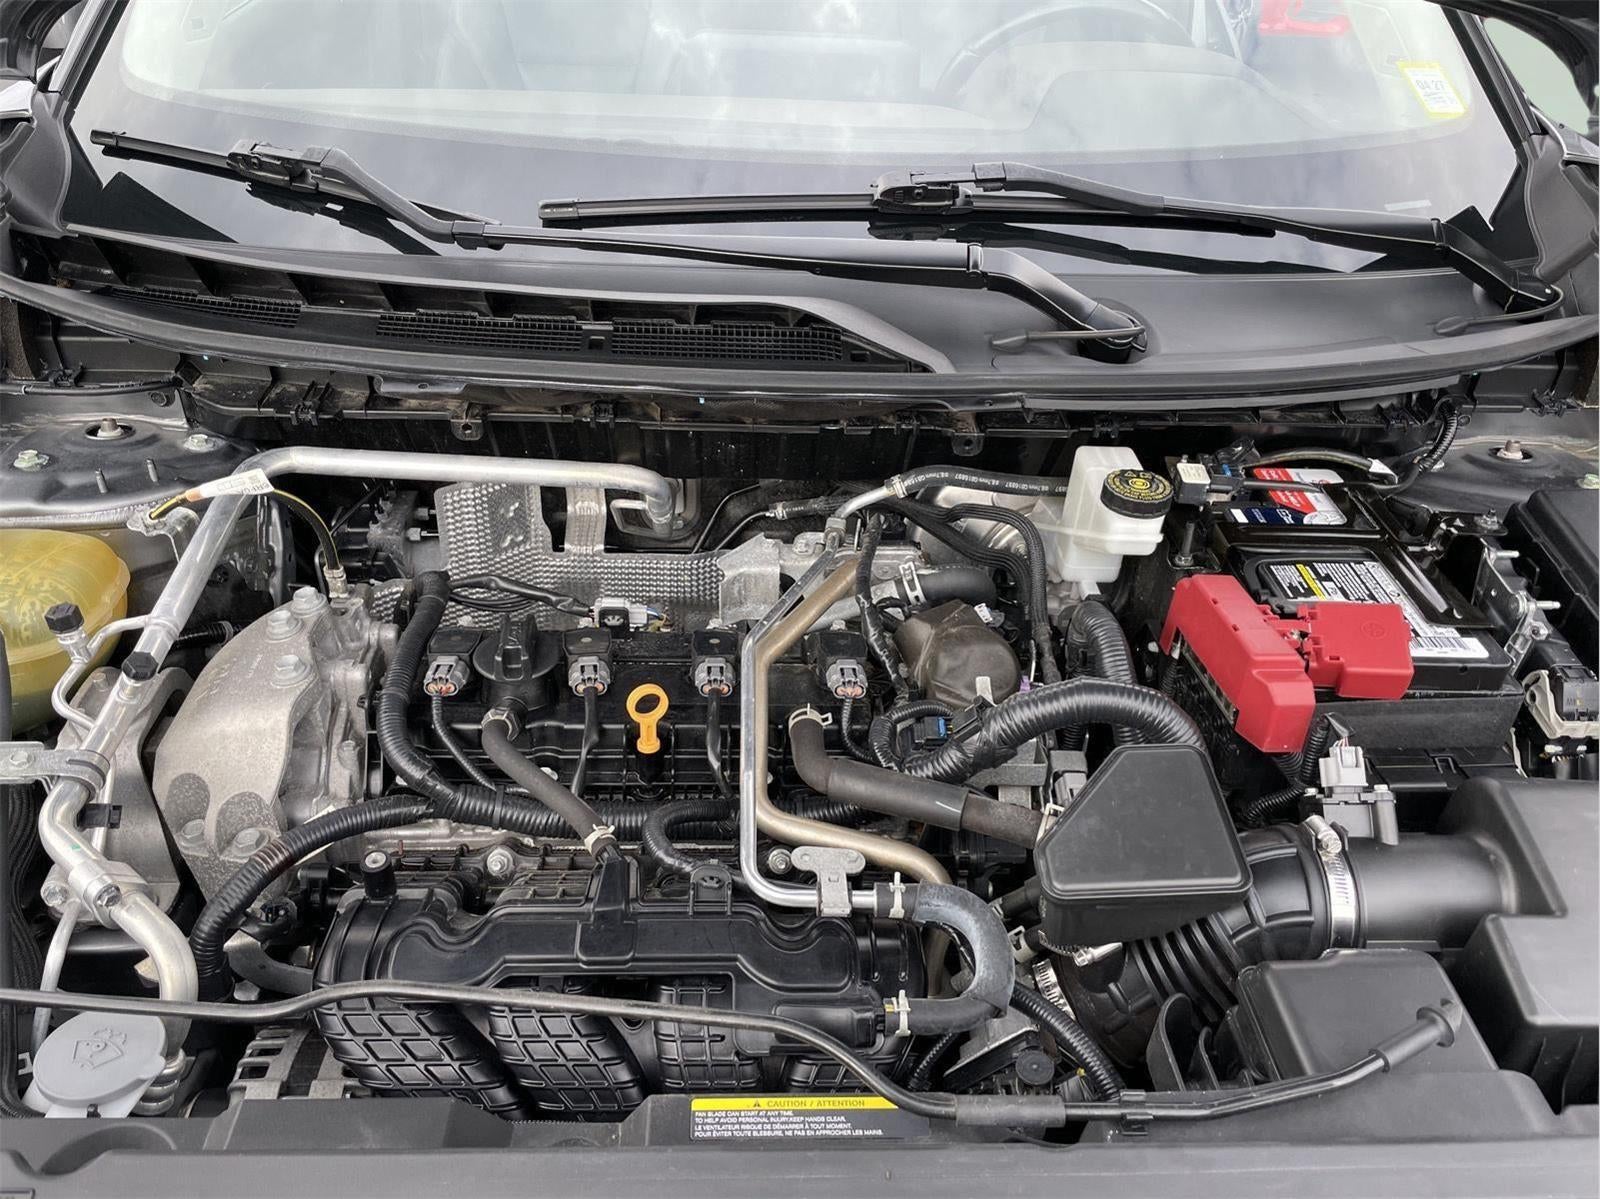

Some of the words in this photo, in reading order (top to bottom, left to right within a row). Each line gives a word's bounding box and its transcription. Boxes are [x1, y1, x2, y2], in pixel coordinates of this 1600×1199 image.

[767, 1100, 806, 1108] CAUTION
[816, 1099, 865, 1107] ATTENTION
[772, 1122, 804, 1130] DÉMARRER
[712, 1129, 733, 1137] ÉVITER
